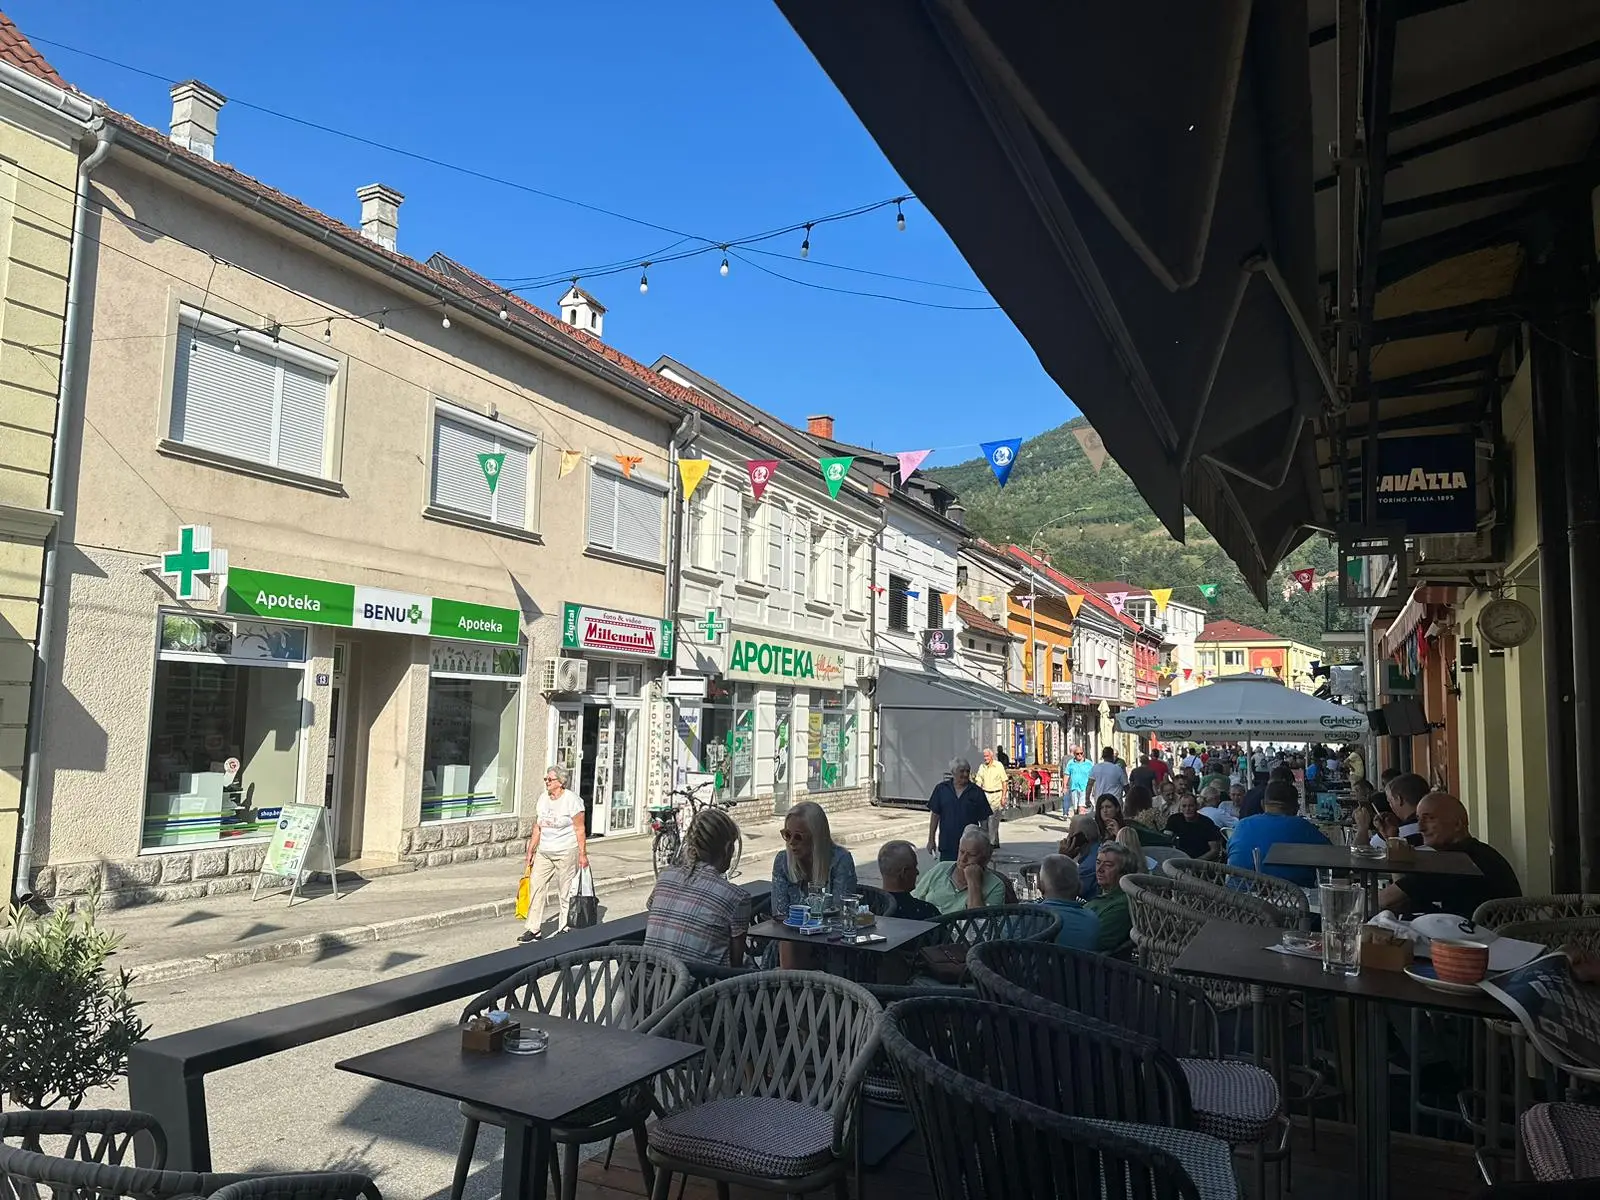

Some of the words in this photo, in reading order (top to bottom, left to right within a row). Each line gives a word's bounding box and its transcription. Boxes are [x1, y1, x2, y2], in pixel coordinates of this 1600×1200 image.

[256, 590, 321, 613] Apoteka
[363, 602, 407, 623] BENU
[603, 612, 617, 621] foto
[626, 616, 642, 625] video
[458, 615, 503, 633] Apoteka
[565, 609, 576, 643] digital
[663, 624, 672, 654] digital
[729, 639, 815, 679] APOTEKA
[318, 675, 328, 685] 13
[1126, 715, 1164, 729] Carlsberg
[1320, 715, 1363, 729] Carlsberg
